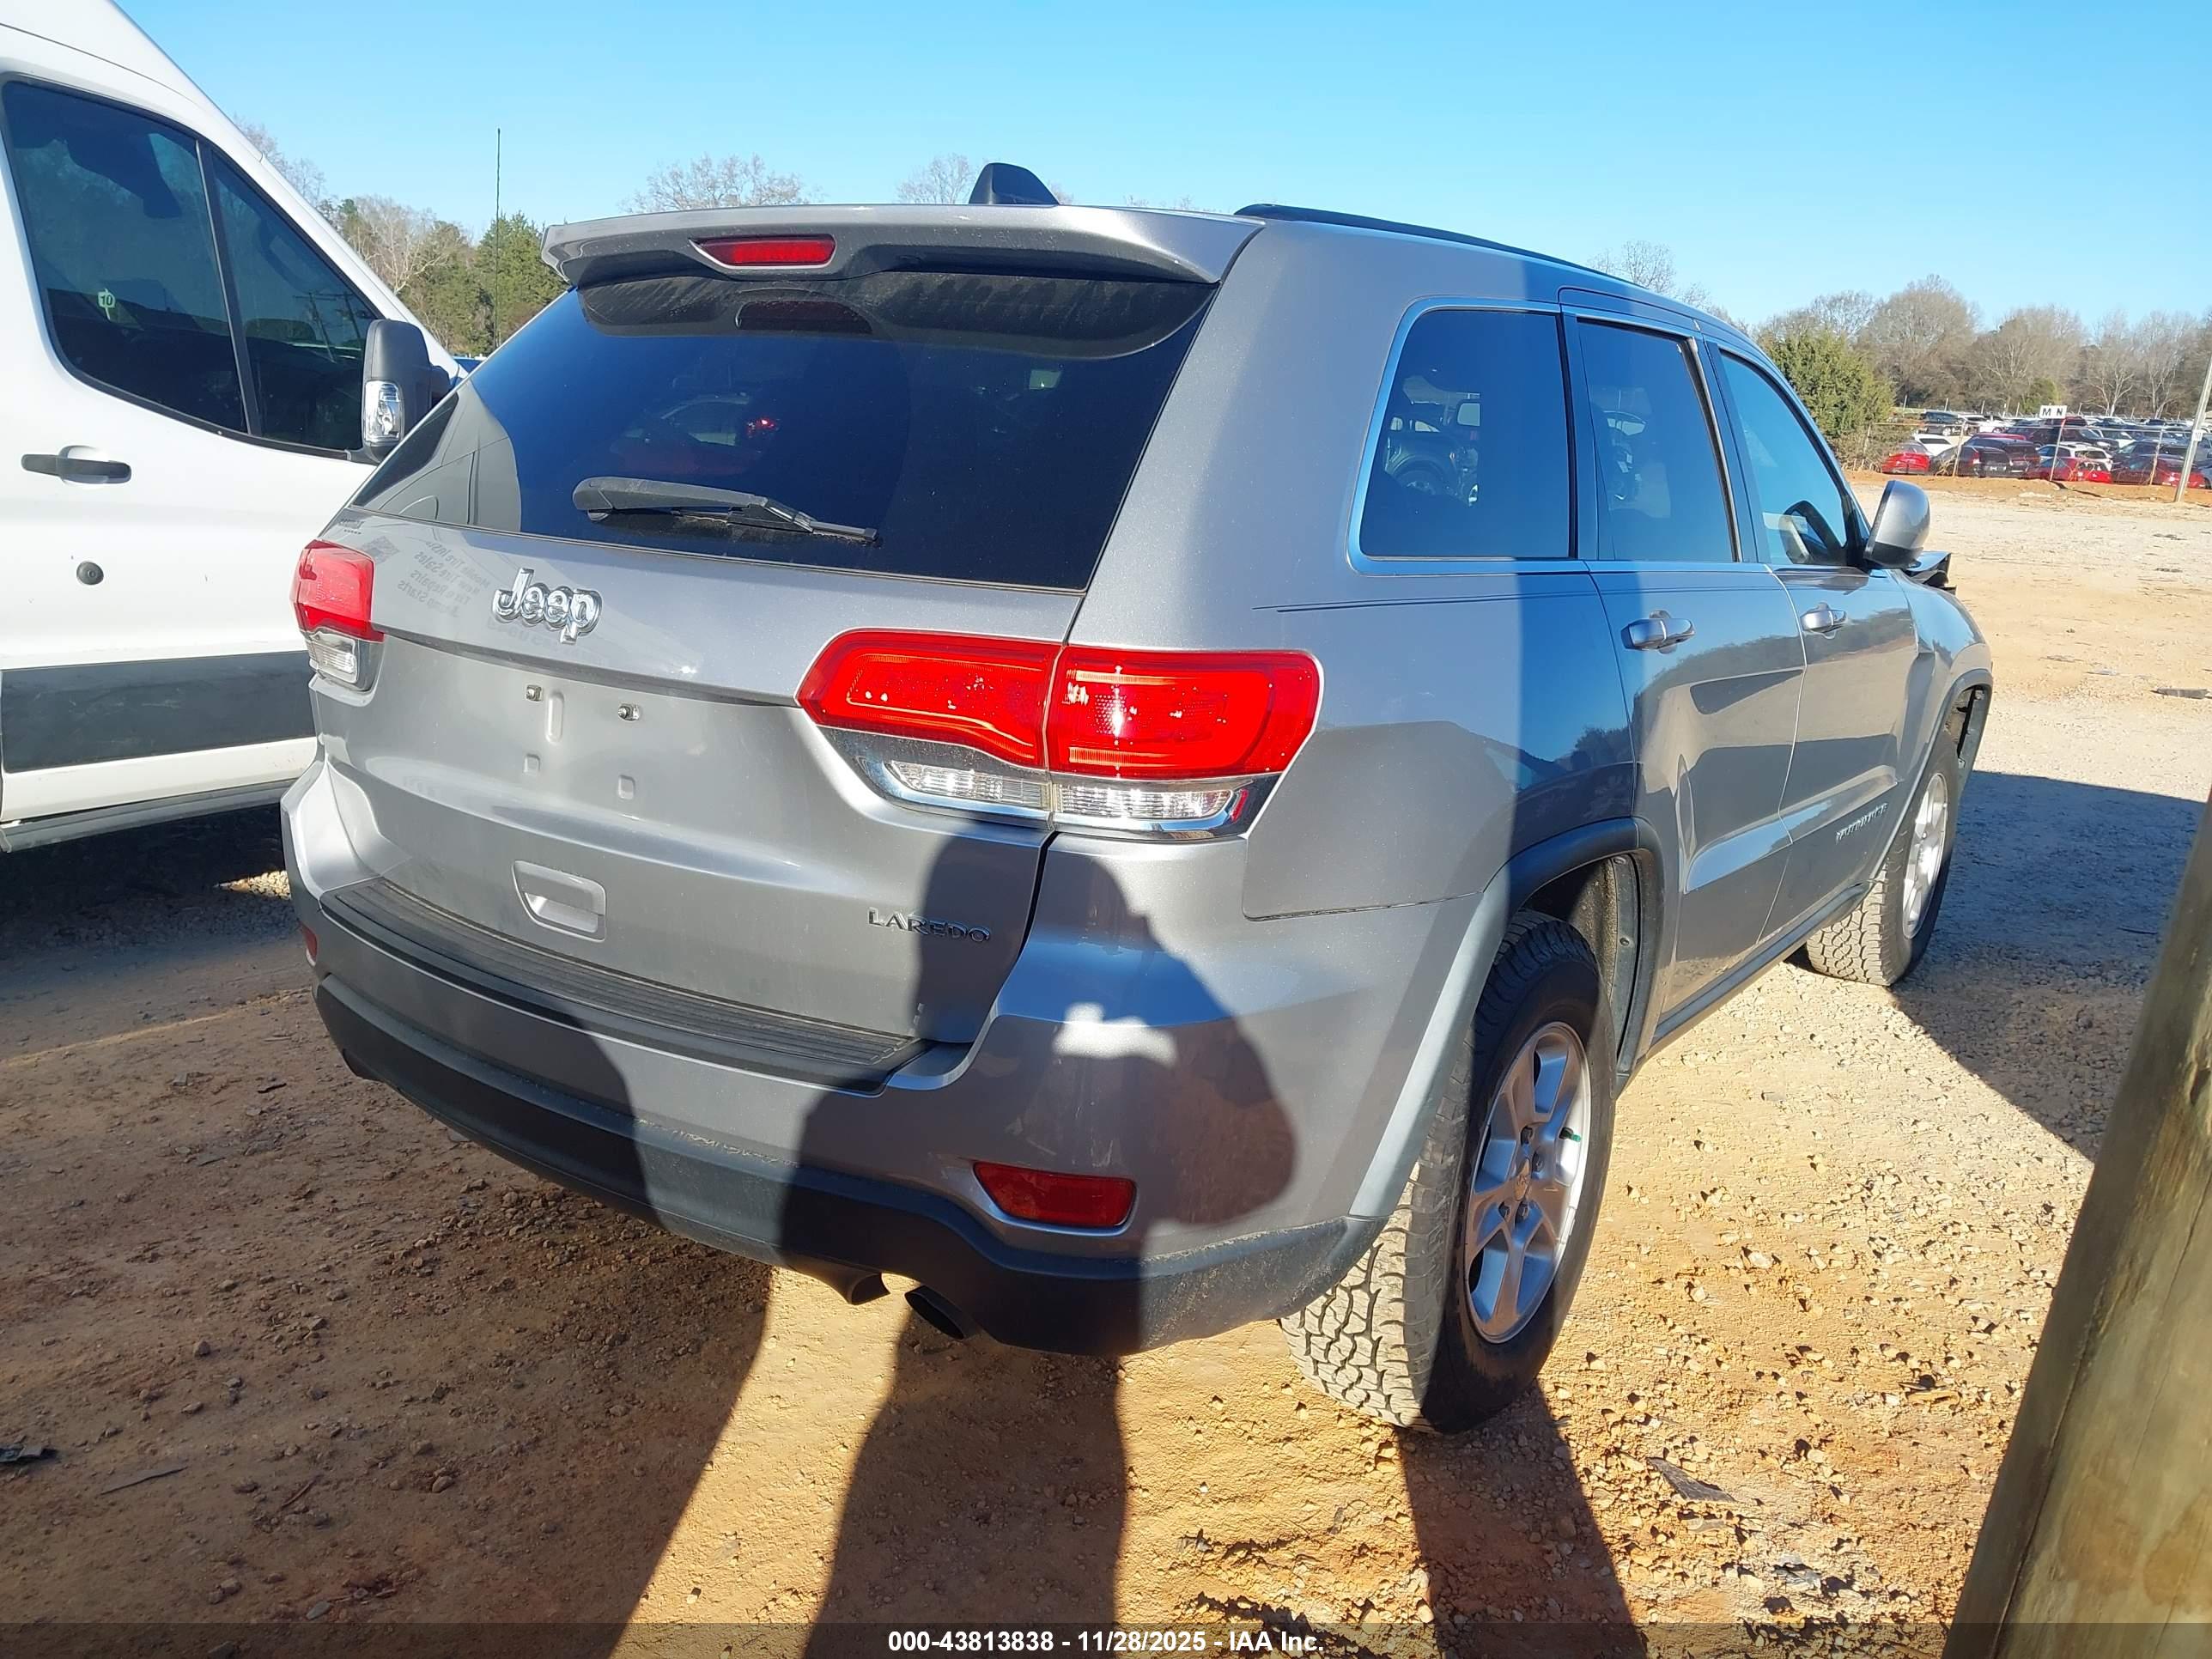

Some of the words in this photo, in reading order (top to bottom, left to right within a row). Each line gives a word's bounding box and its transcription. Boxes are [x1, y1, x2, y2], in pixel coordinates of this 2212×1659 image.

[2042, 407, 2051, 416] M
[2057, 407, 2063, 416] N
[492, 567, 603, 645] Jeep
[867, 907, 992, 943] LAREDO
